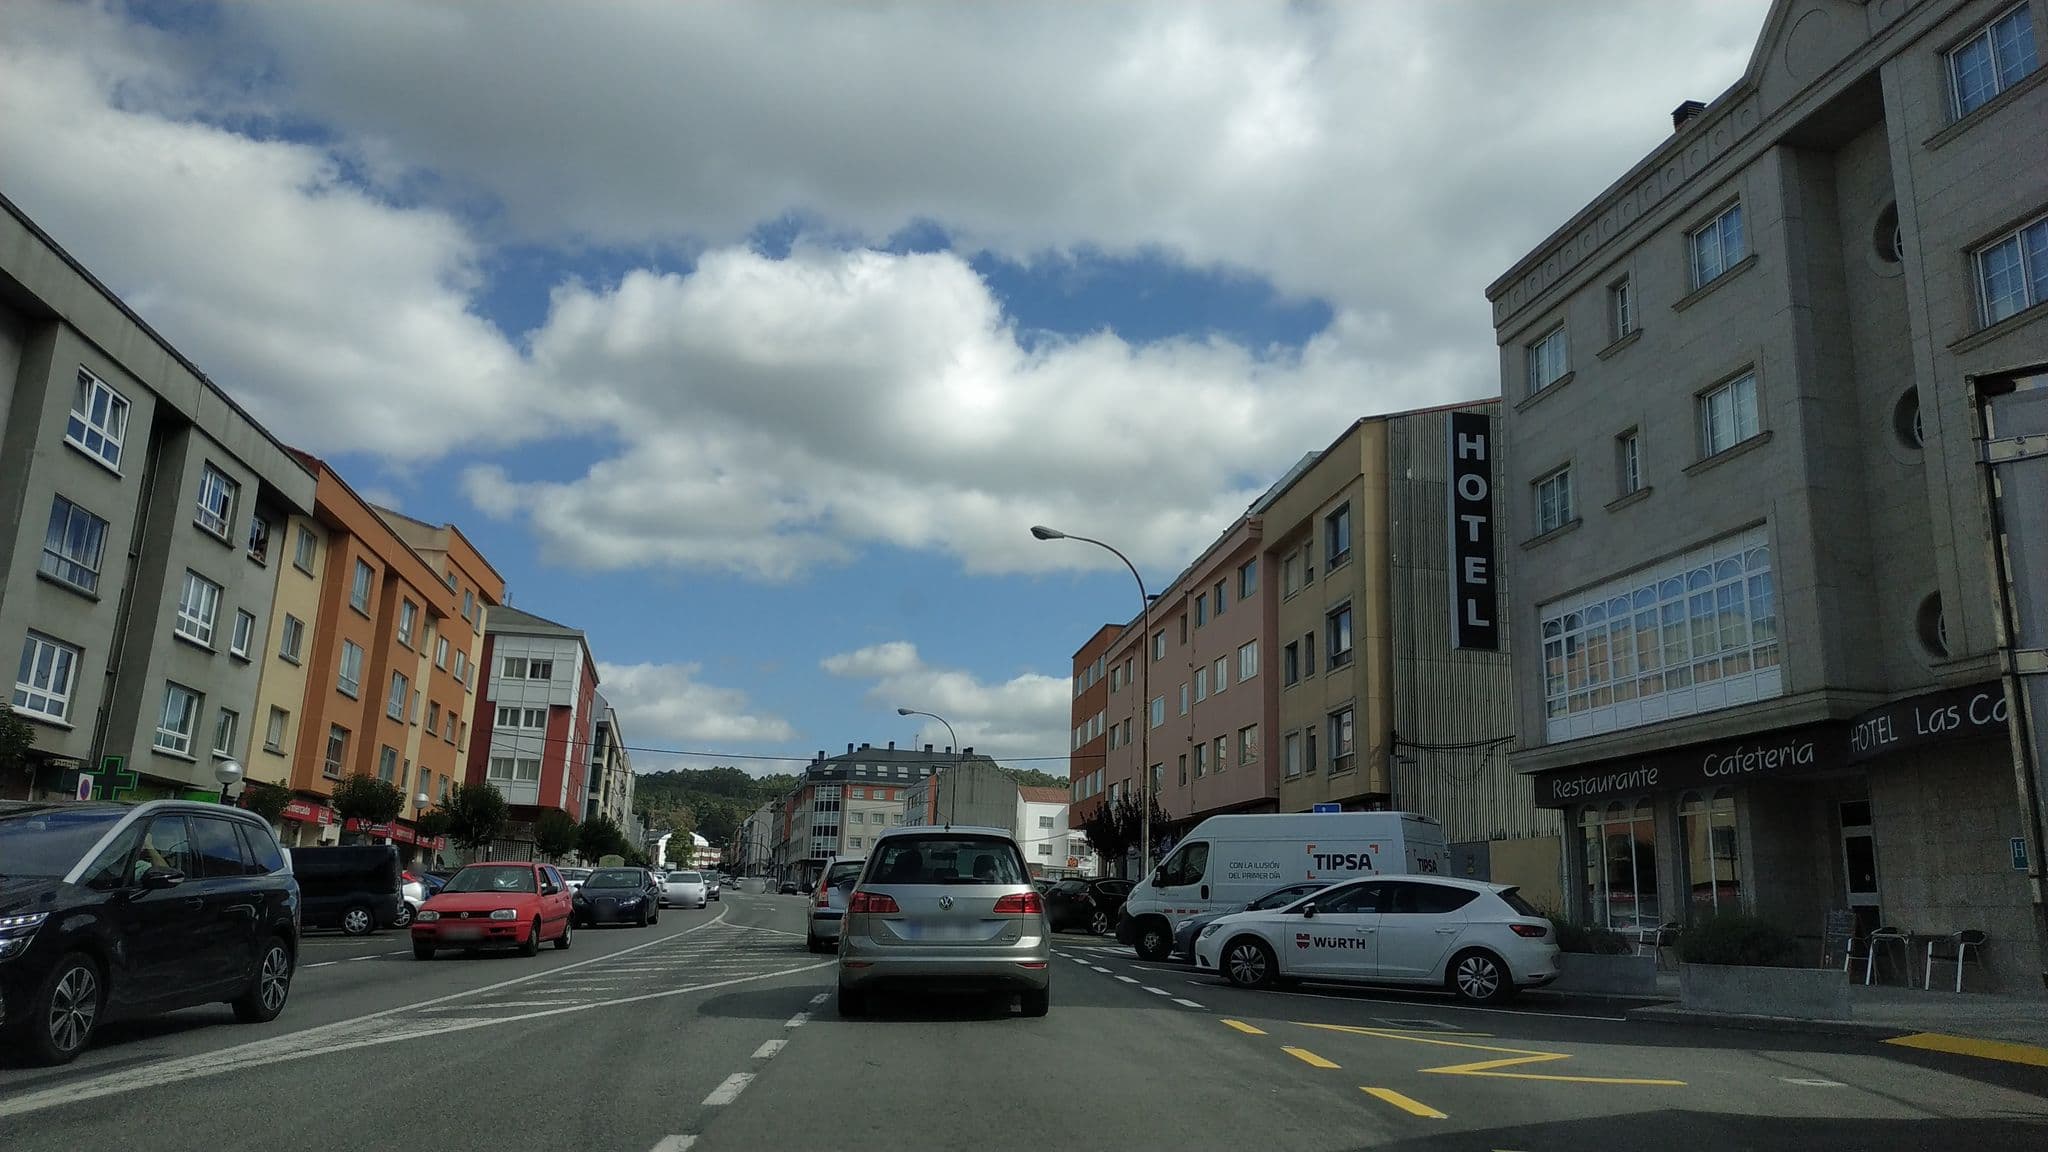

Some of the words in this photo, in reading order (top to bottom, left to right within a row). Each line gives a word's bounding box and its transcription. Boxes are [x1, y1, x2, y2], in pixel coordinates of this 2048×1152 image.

[1458, 432, 1490, 627] HOTEL
[1851, 715, 1898, 752] HOTEL
[1915, 705, 1960, 735] Las
[1703, 739, 1815, 778] Cafetería
[1552, 765, 1658, 799] Restaurante
[1269, 871, 1281, 879] DÍA
[1313, 853, 1372, 871] TIPSA
[1416, 857, 1438, 873] TIPSA
[1313, 936, 1366, 950] WÜRTH
